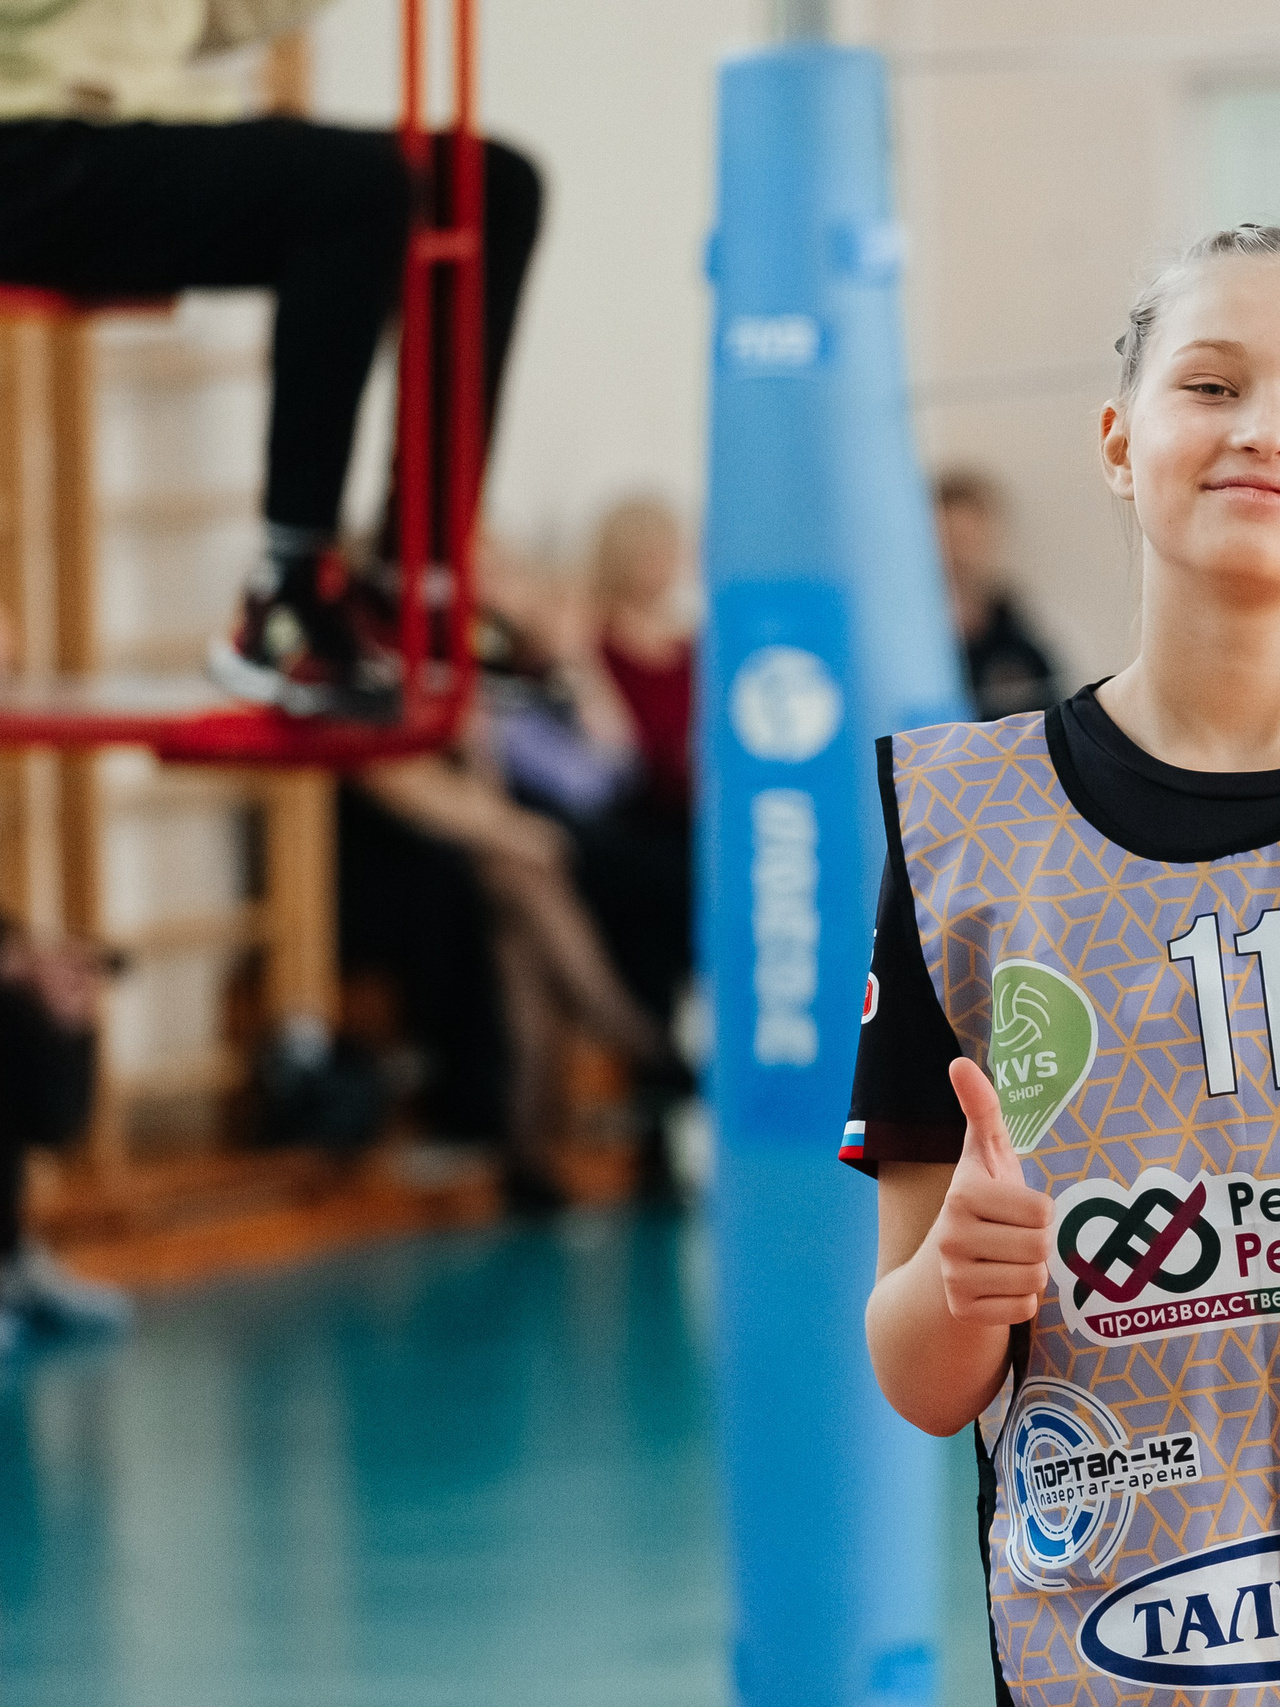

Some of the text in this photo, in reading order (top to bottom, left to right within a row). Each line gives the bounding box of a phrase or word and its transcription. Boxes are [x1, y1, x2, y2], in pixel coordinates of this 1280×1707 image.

[995, 1050, 1058, 1090] KVS
[1008, 1083, 1044, 1103] SHOP
[1040, 1464, 1197, 1506] лазертаг-арена
